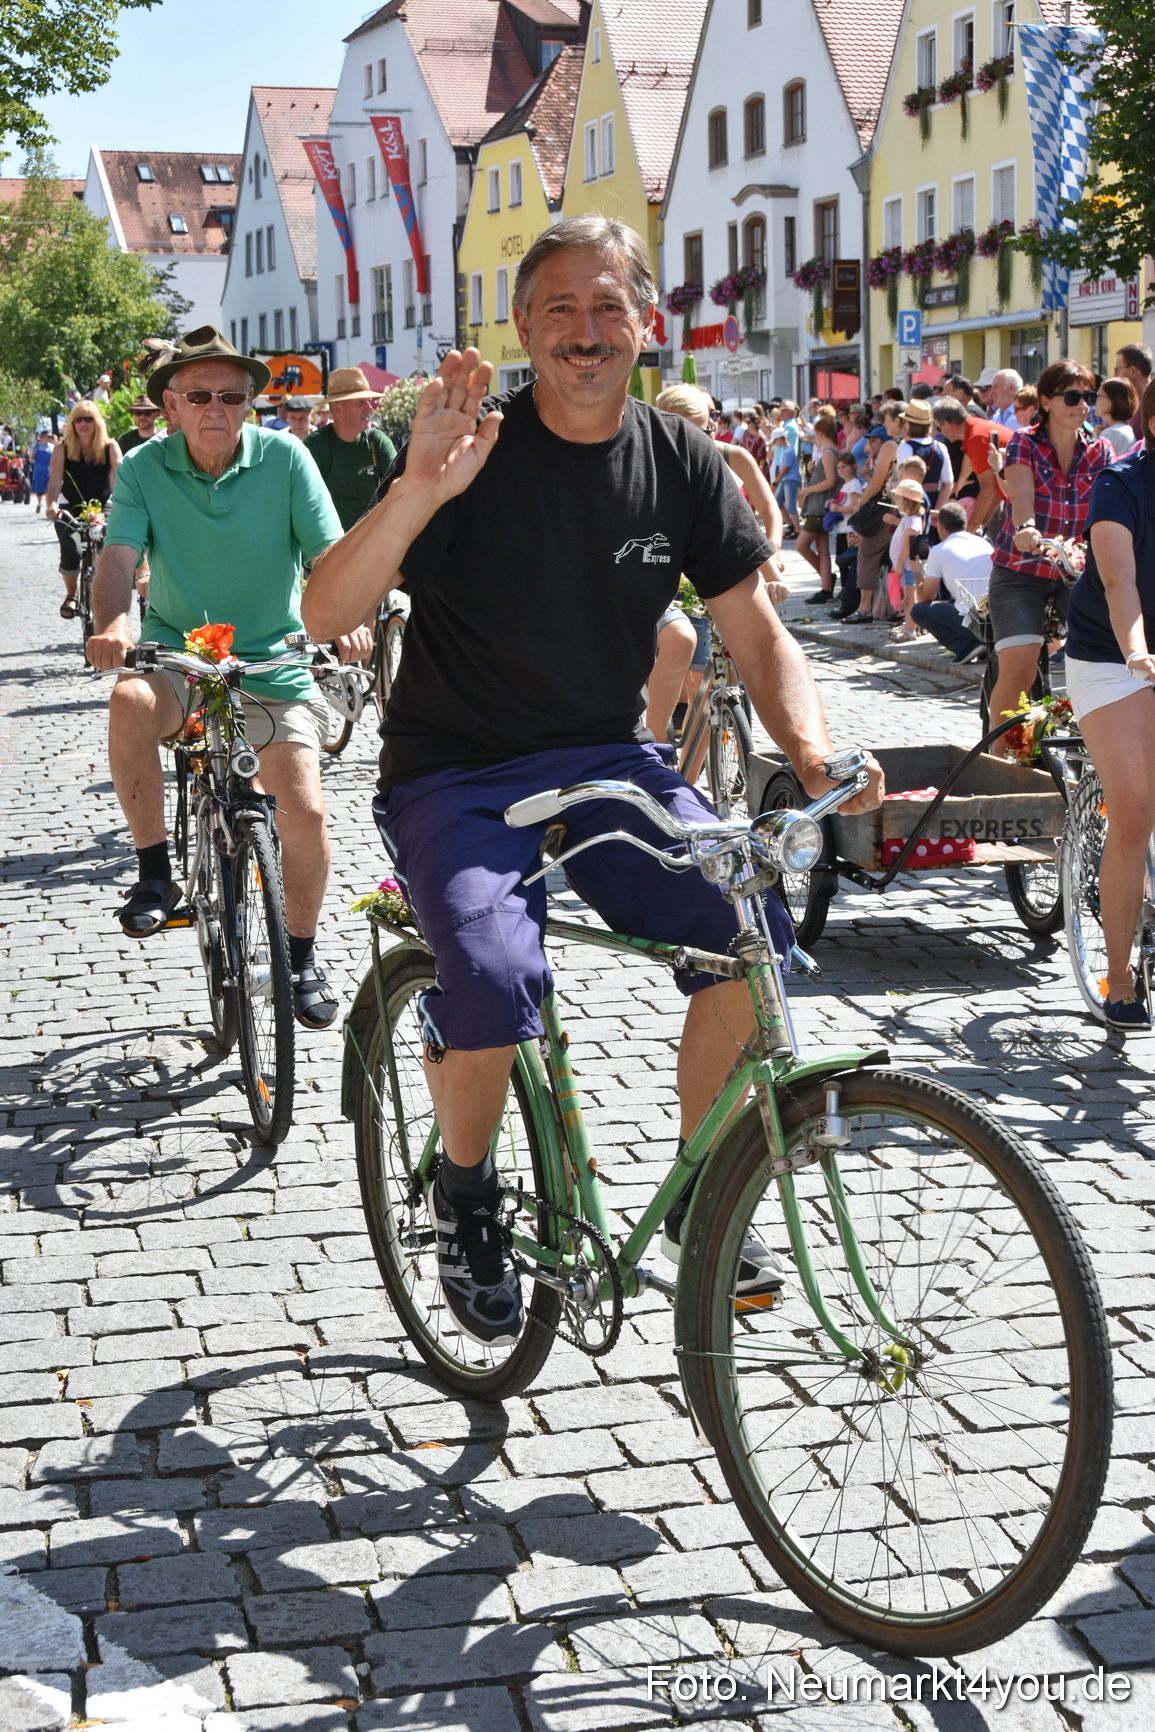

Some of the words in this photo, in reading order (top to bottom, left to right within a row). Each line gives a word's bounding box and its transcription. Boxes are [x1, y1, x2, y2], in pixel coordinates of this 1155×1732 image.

[379, 120, 402, 160] K&L
[500, 234, 525, 259] HOTEL
[903, 314, 917, 342] P
[939, 818, 1043, 839] EXPRESS
